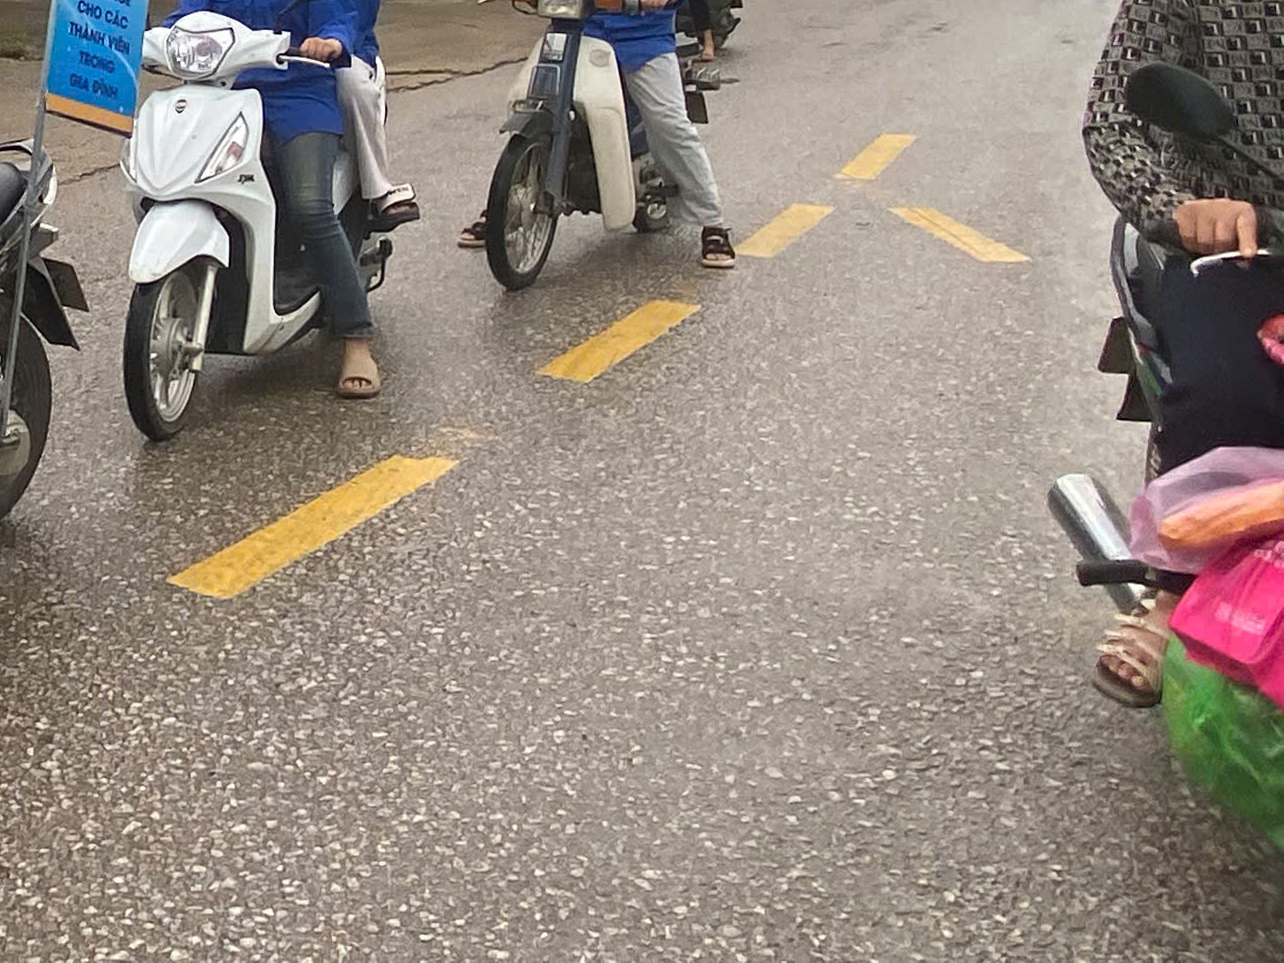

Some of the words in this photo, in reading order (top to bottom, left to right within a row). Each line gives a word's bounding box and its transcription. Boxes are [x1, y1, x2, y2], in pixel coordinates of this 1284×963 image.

[77, 0, 103, 20] CHO
[104, 9, 129, 30] CÁC
[68, 20, 106, 47] THÀNH
